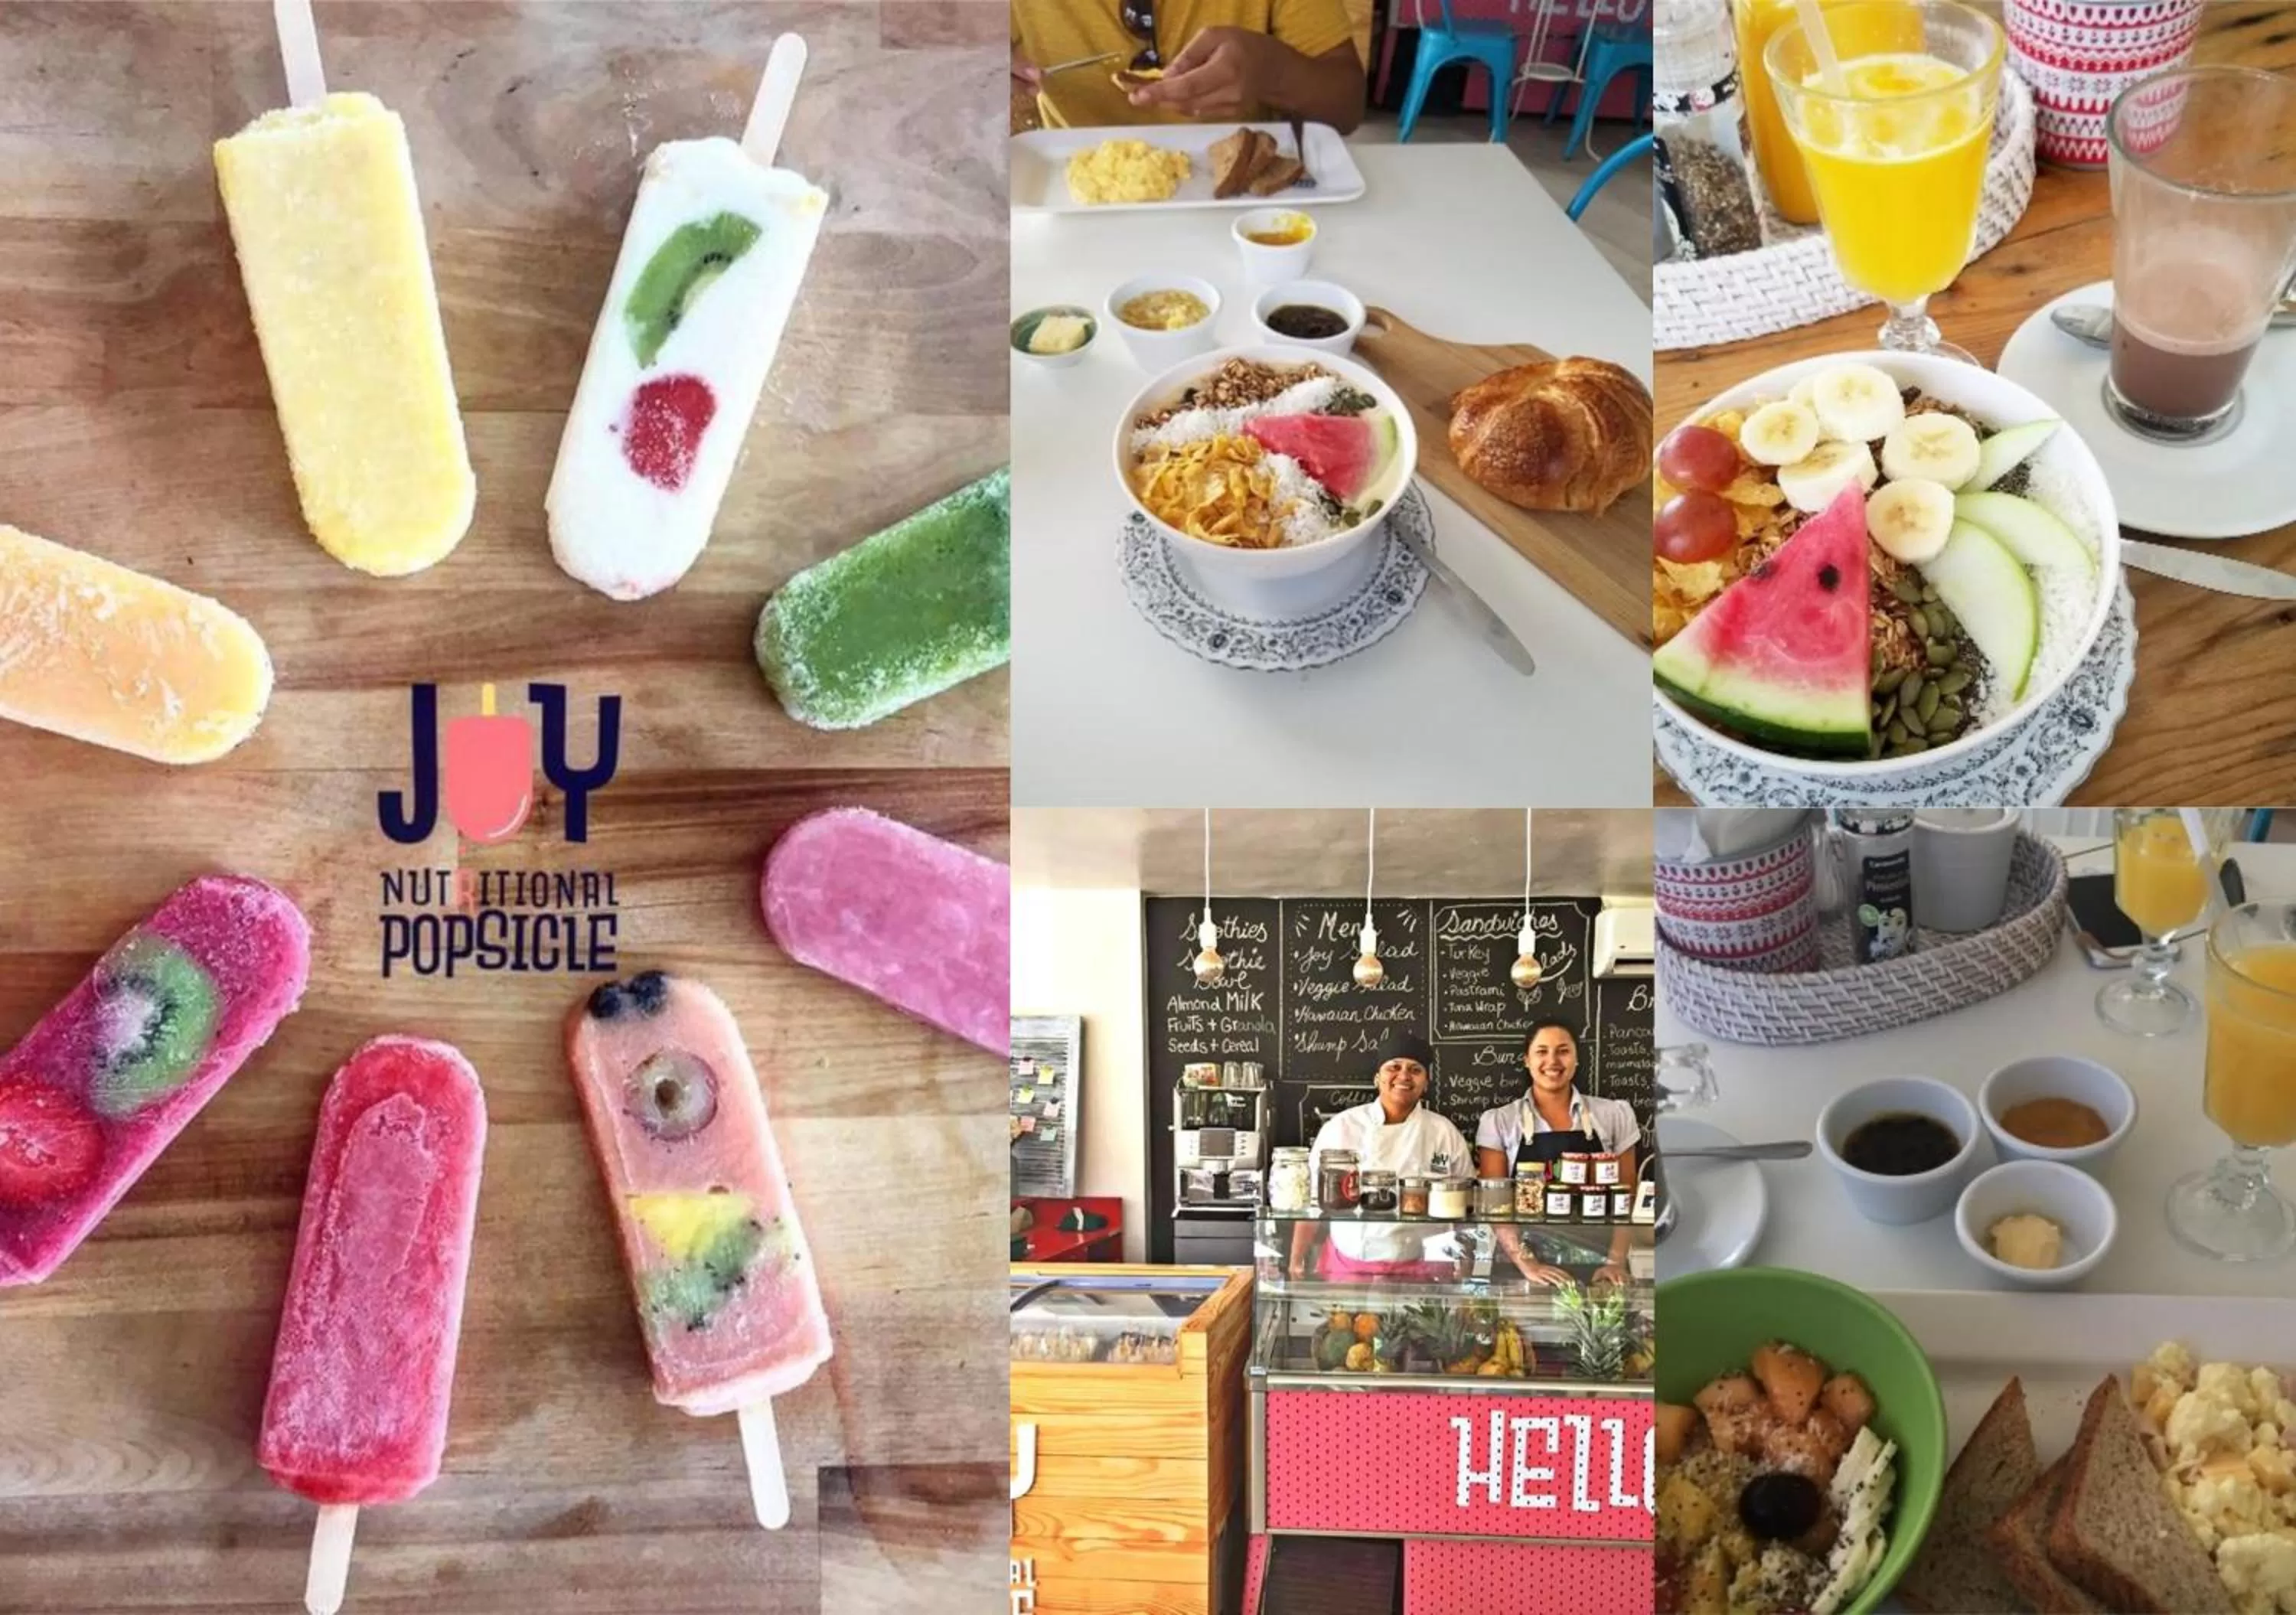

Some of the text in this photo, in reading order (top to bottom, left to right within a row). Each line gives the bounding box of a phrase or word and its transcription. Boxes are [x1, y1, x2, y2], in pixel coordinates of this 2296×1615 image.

[1319, 911, 1382, 941] Men
[1299, 976, 1349, 1001] Veggie
[1166, 995, 1224, 1013] Almond
[1220, 1014, 1277, 1035] Granola
[1168, 1037, 1208, 1054] Seeds
[1221, 1037, 1260, 1054] Cereal
[1449, 1074, 1494, 1093] Veggie
[1450, 1409, 1655, 1515] HELL
